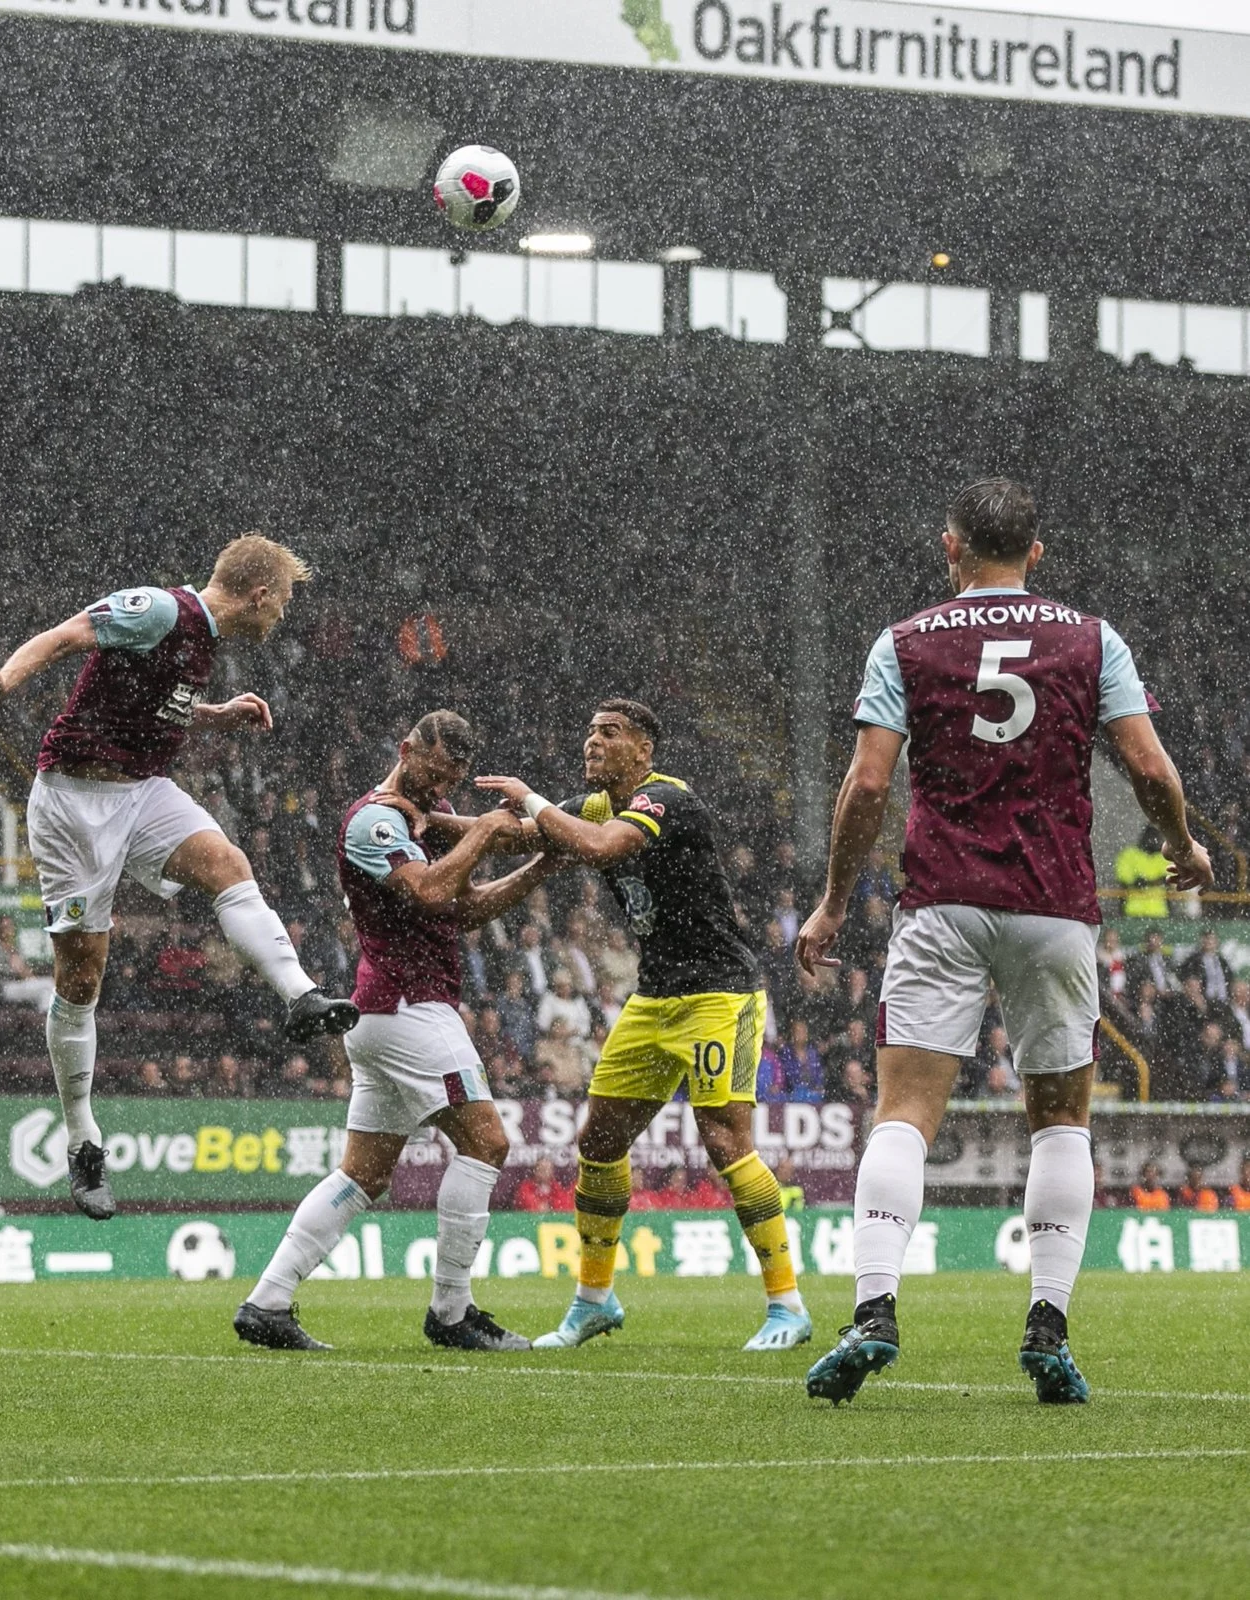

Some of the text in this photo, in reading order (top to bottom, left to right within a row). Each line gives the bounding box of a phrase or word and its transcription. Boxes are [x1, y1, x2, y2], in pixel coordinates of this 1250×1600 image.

[693, 0, 1181, 97] Oakfurnitureland
[914, 604, 1082, 633] TARKOWSKI
[971, 640, 1037, 744] 5
[693, 1040, 726, 1078] 10
[104, 1126, 285, 1174] oveBet
[866, 1208, 906, 1226] BFC
[1030, 1222, 1070, 1234] BFC
